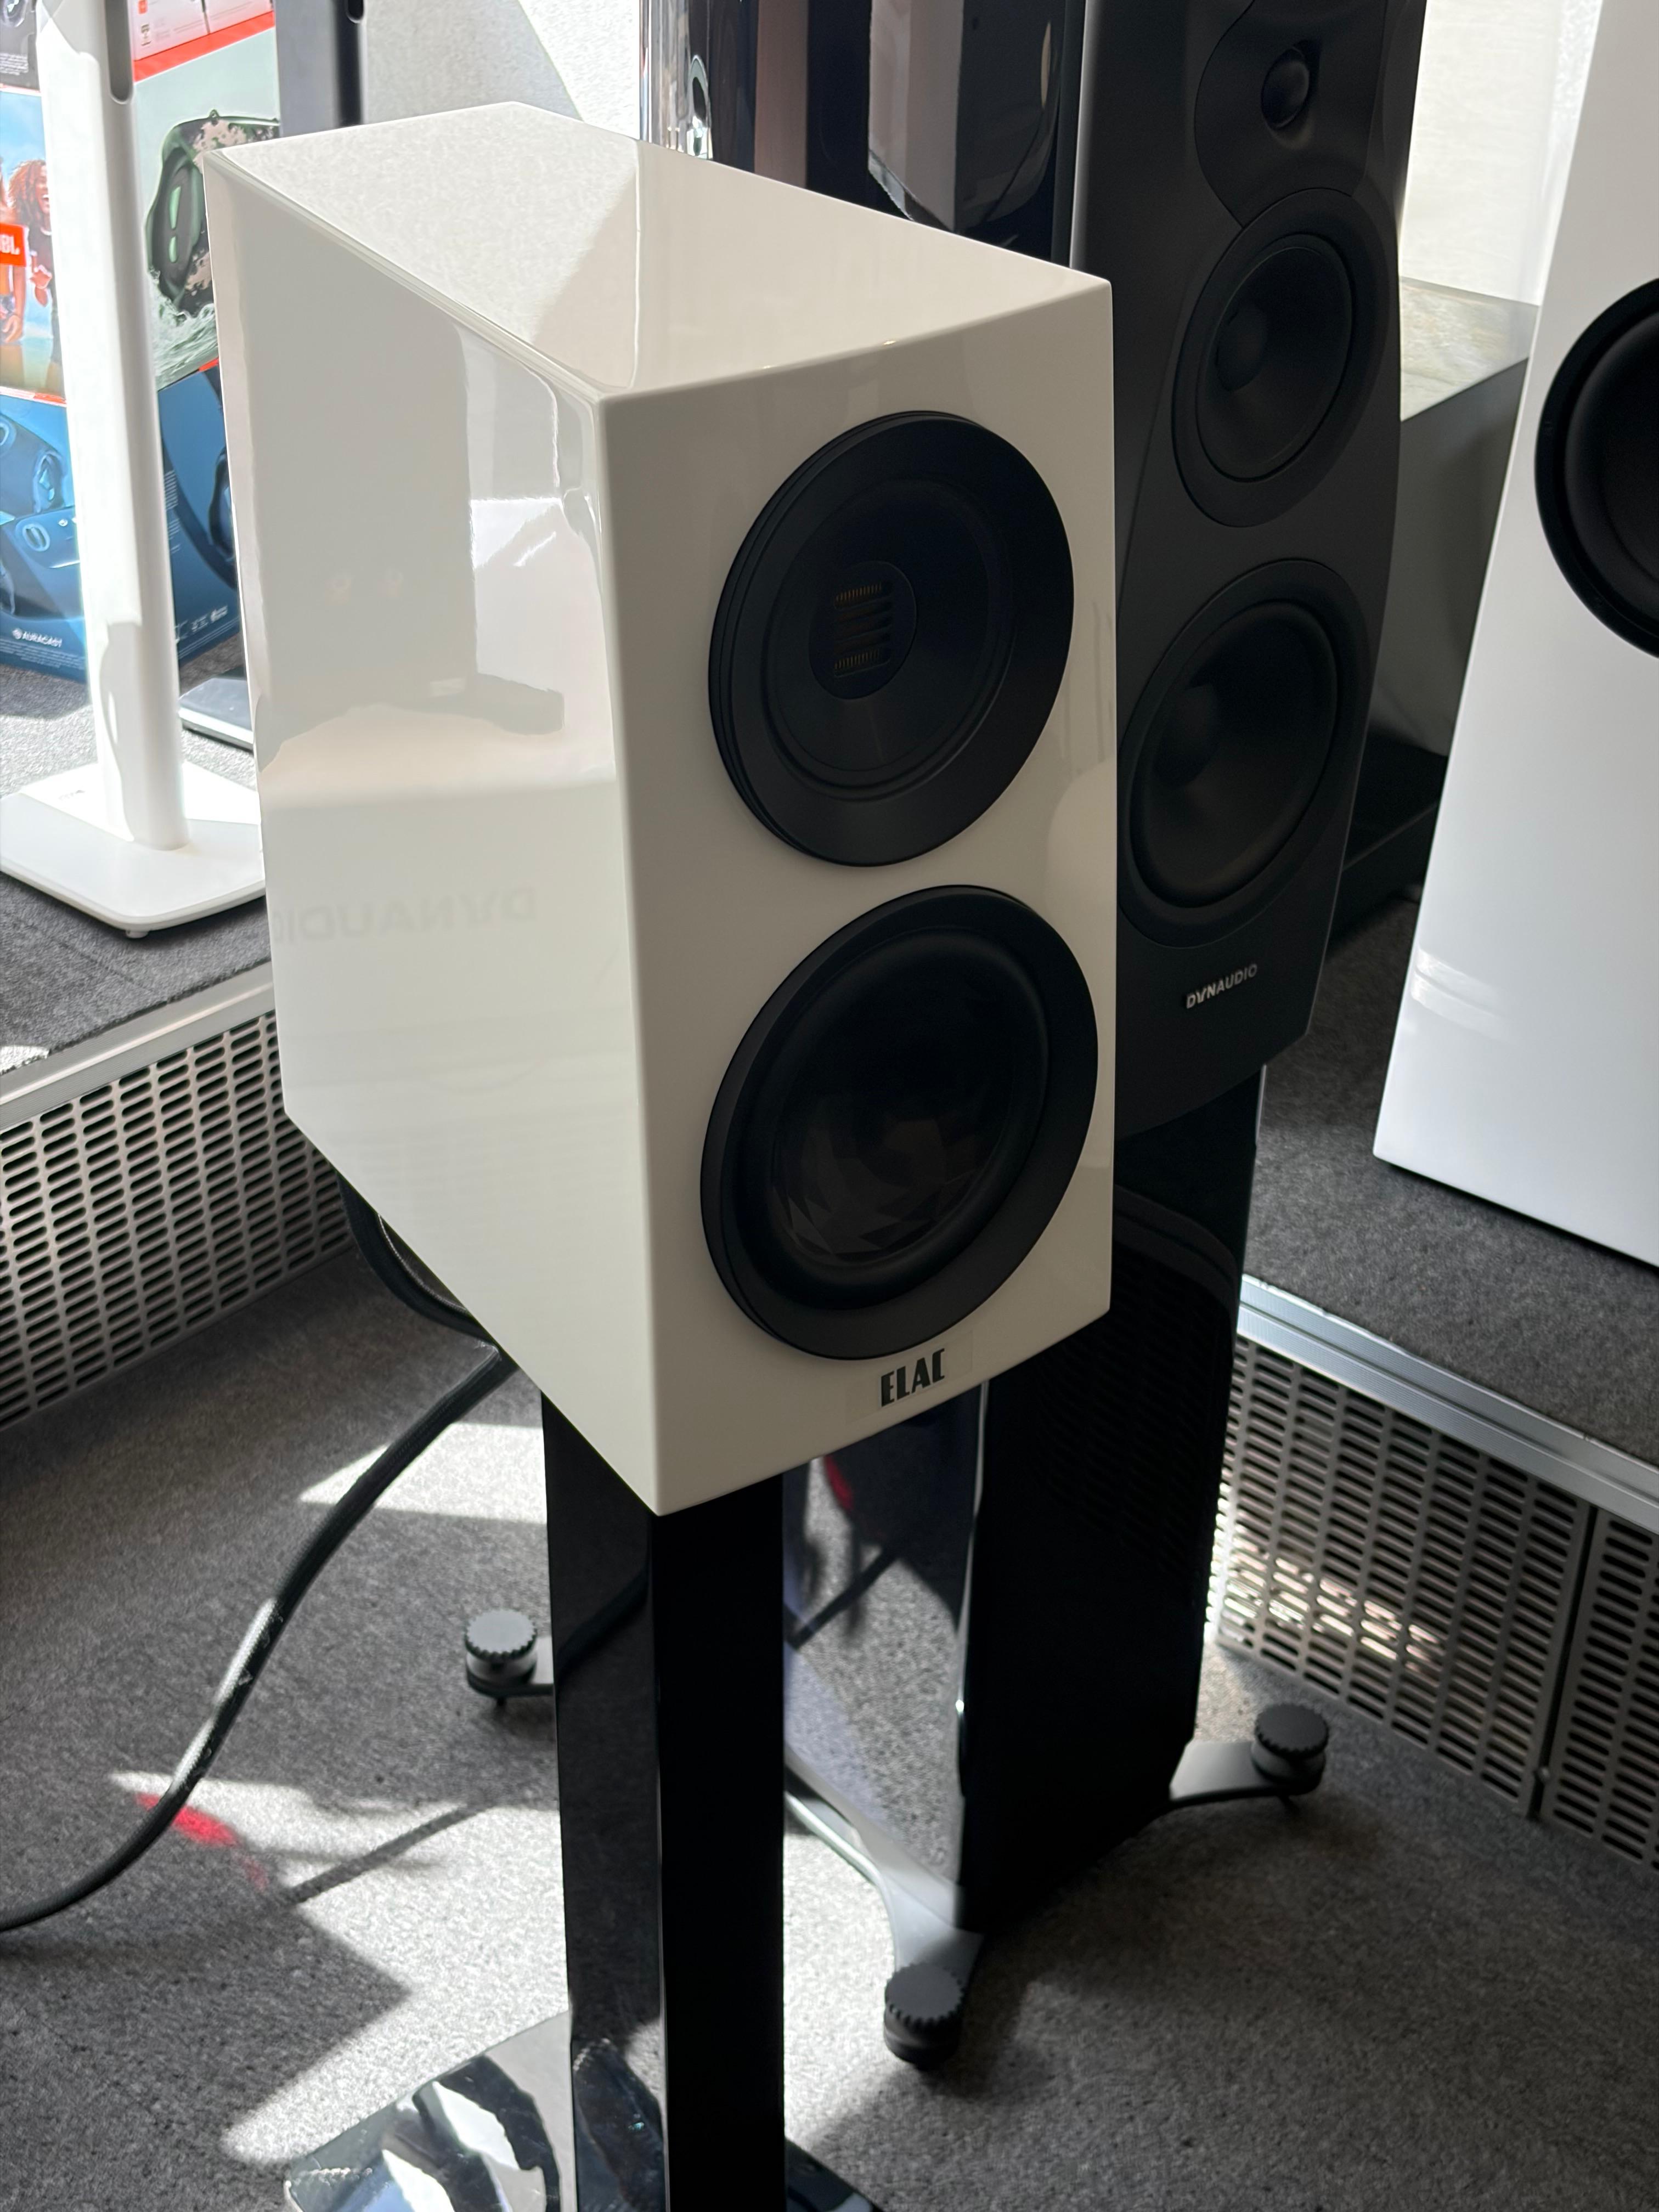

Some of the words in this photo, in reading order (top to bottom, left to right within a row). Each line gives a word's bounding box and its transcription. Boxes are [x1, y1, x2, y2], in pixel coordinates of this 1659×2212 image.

[0, 234, 20, 255] BL
[1186, 963, 1257, 1009] DYNAUDIO
[881, 1348, 945, 1407] ELAC
